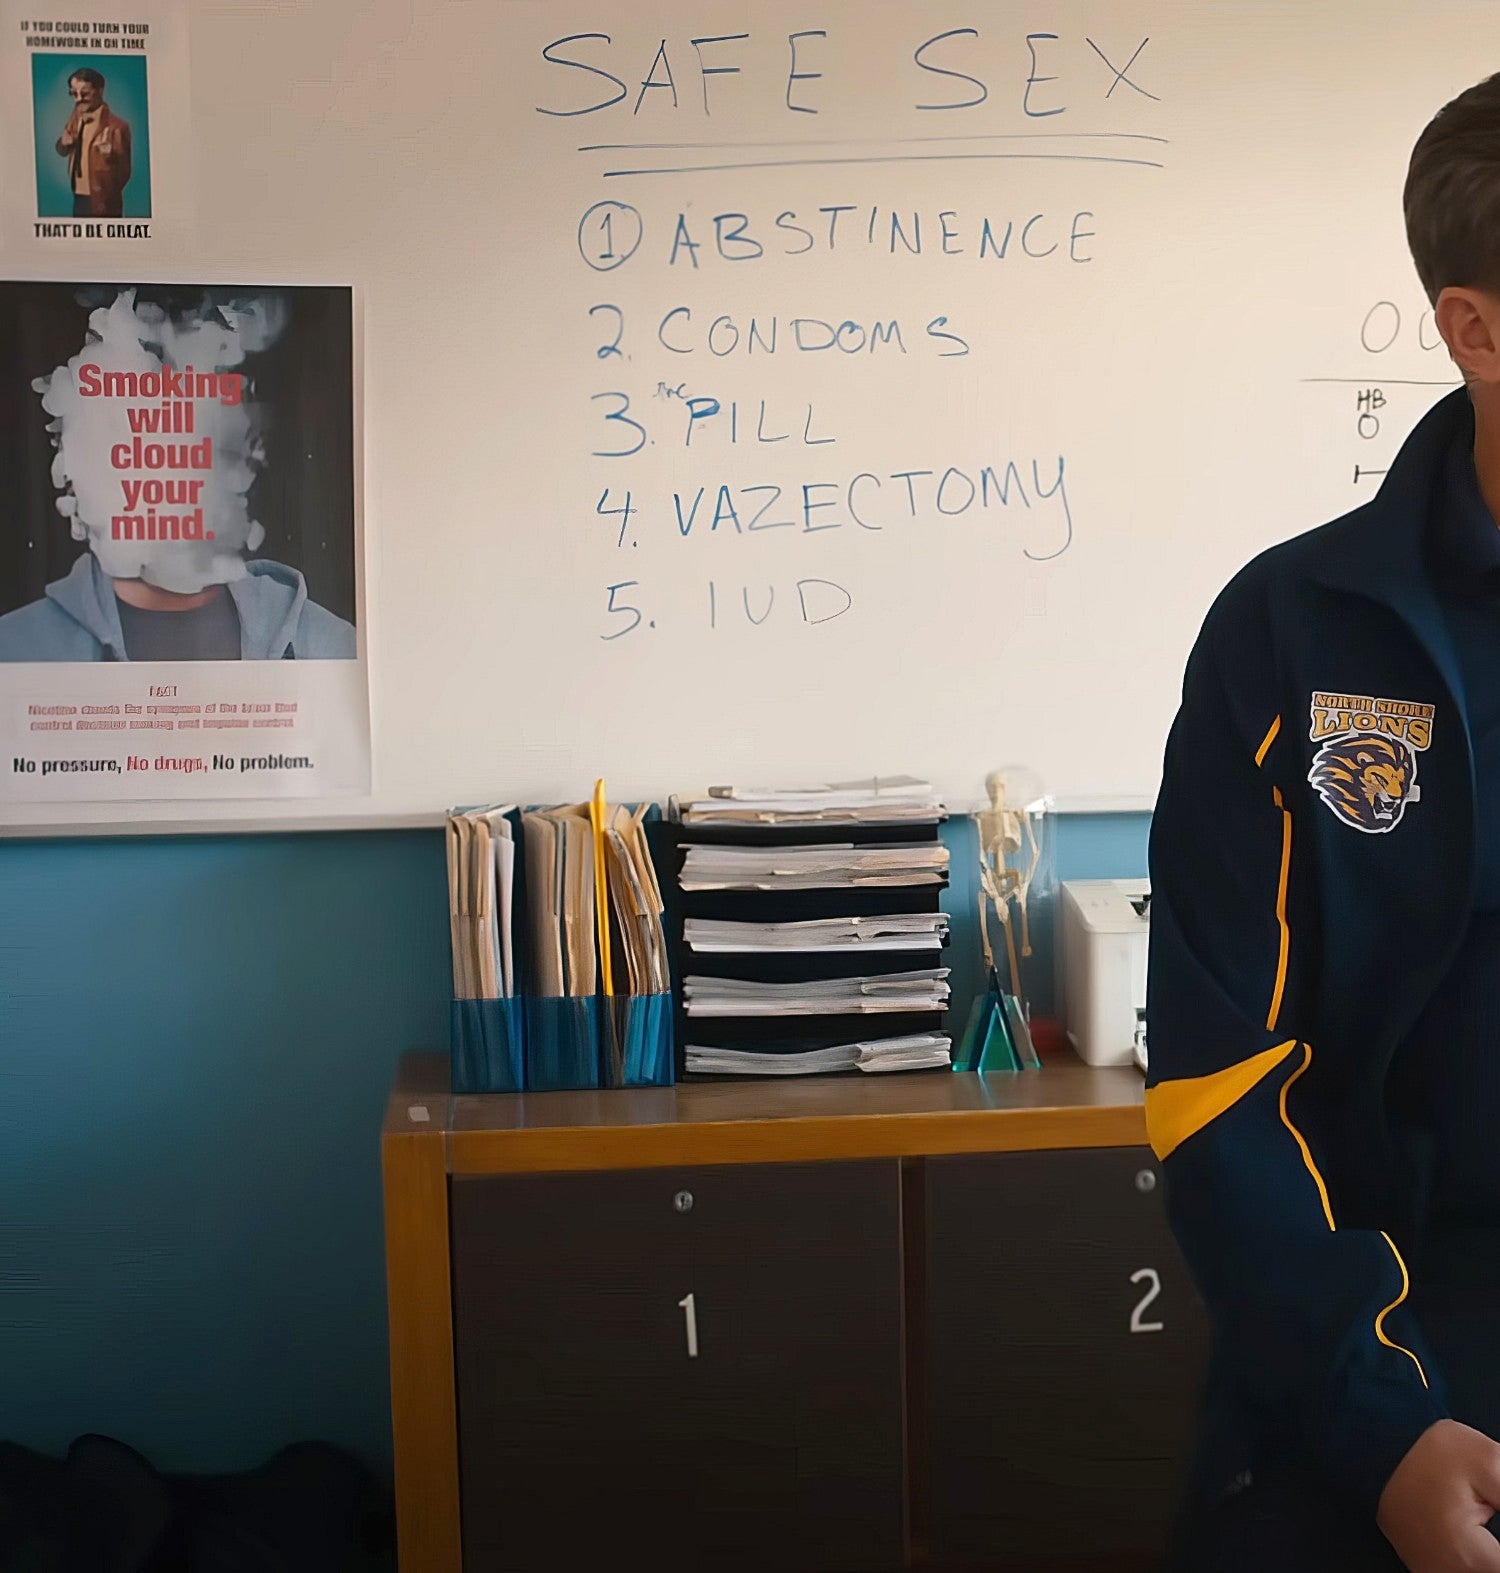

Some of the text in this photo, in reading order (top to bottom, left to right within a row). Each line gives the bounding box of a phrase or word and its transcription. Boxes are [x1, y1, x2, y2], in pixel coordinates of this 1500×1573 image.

[26, 36, 88, 48] HOMEWORK
[91, 38, 102, 48] IN
[121, 38, 145, 49] TIME
[33, 21, 53, 32] YOU
[55, 21, 89, 33] COULD
[93, 22, 119, 34] TURN
[122, 23, 149, 35] YOUR
[536, 28, 1161, 117] SAFE SEX
[86, 223, 103, 238] BE
[670, 206, 1096, 269] ABSTINENCE
[658, 306, 970, 357] CONDOMS
[78, 363, 243, 406] Smoking
[126, 401, 194, 433] will
[685, 397, 836, 447] PILL
[110, 437, 213, 469] cloud
[121, 479, 205, 511] your
[673, 455, 1072, 560] VAZECTOMY
[111, 508, 215, 540] mind.
[709, 578, 852, 629] IUD
[1314, 693, 1434, 718] NORTH SHORE
[1312, 709, 1431, 749] LIONS
[13, 757, 36, 773] No
[127, 755, 149, 771] No
[212, 754, 235, 770] No
[240, 754, 314, 772] problem.
[1129, 1268, 1163, 1333] 2
[677, 1293, 698, 1357] 1
